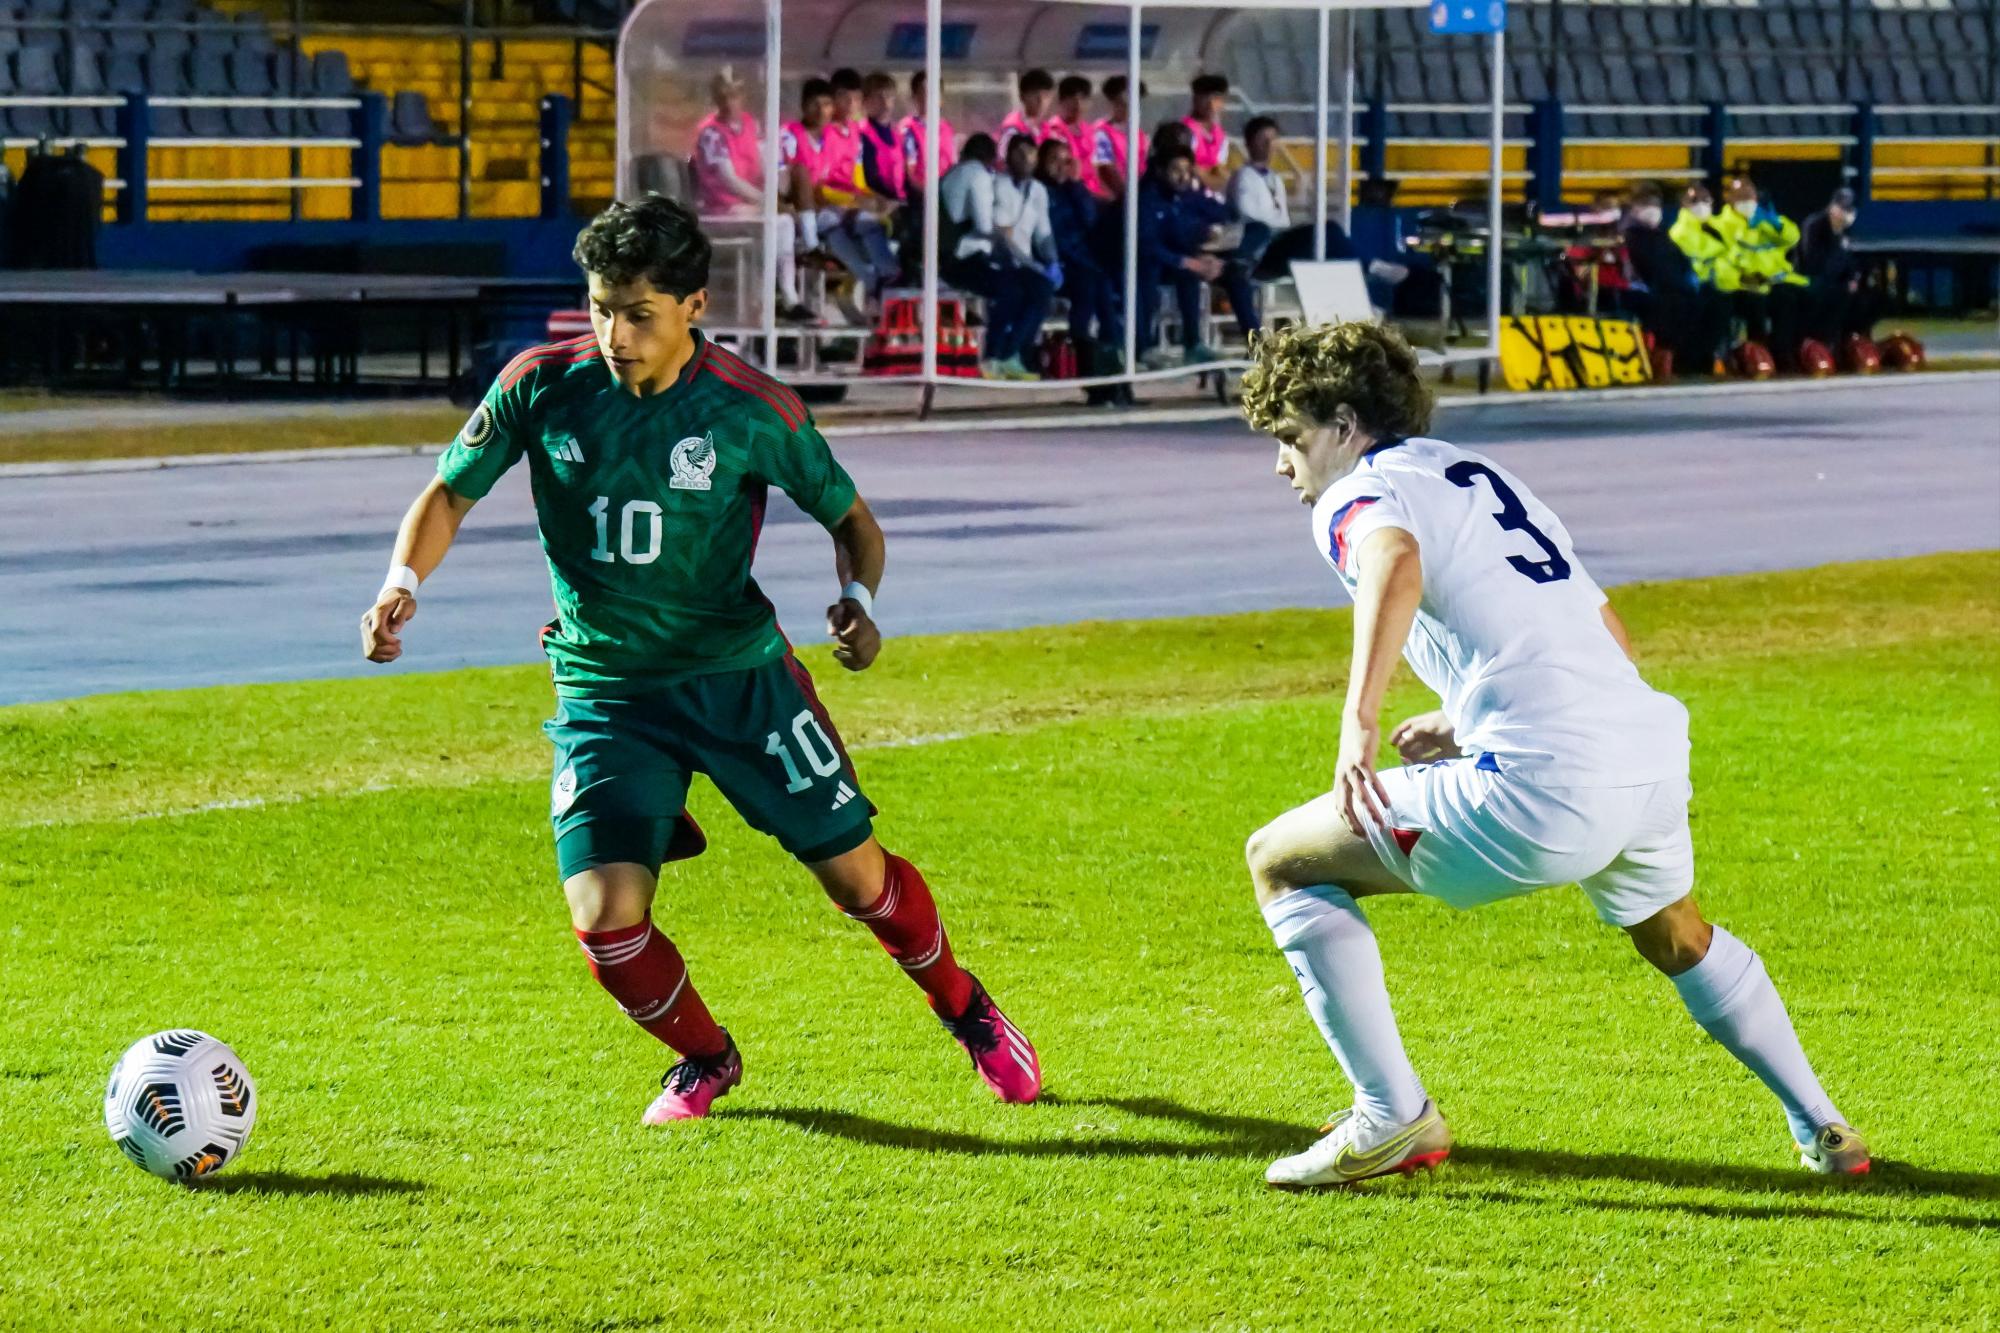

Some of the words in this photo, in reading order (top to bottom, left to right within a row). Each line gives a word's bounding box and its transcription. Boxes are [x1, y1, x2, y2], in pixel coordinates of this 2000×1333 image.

[588, 495, 664, 565] 10
[1445, 461, 1571, 584] 3
[765, 709, 841, 794] 10
